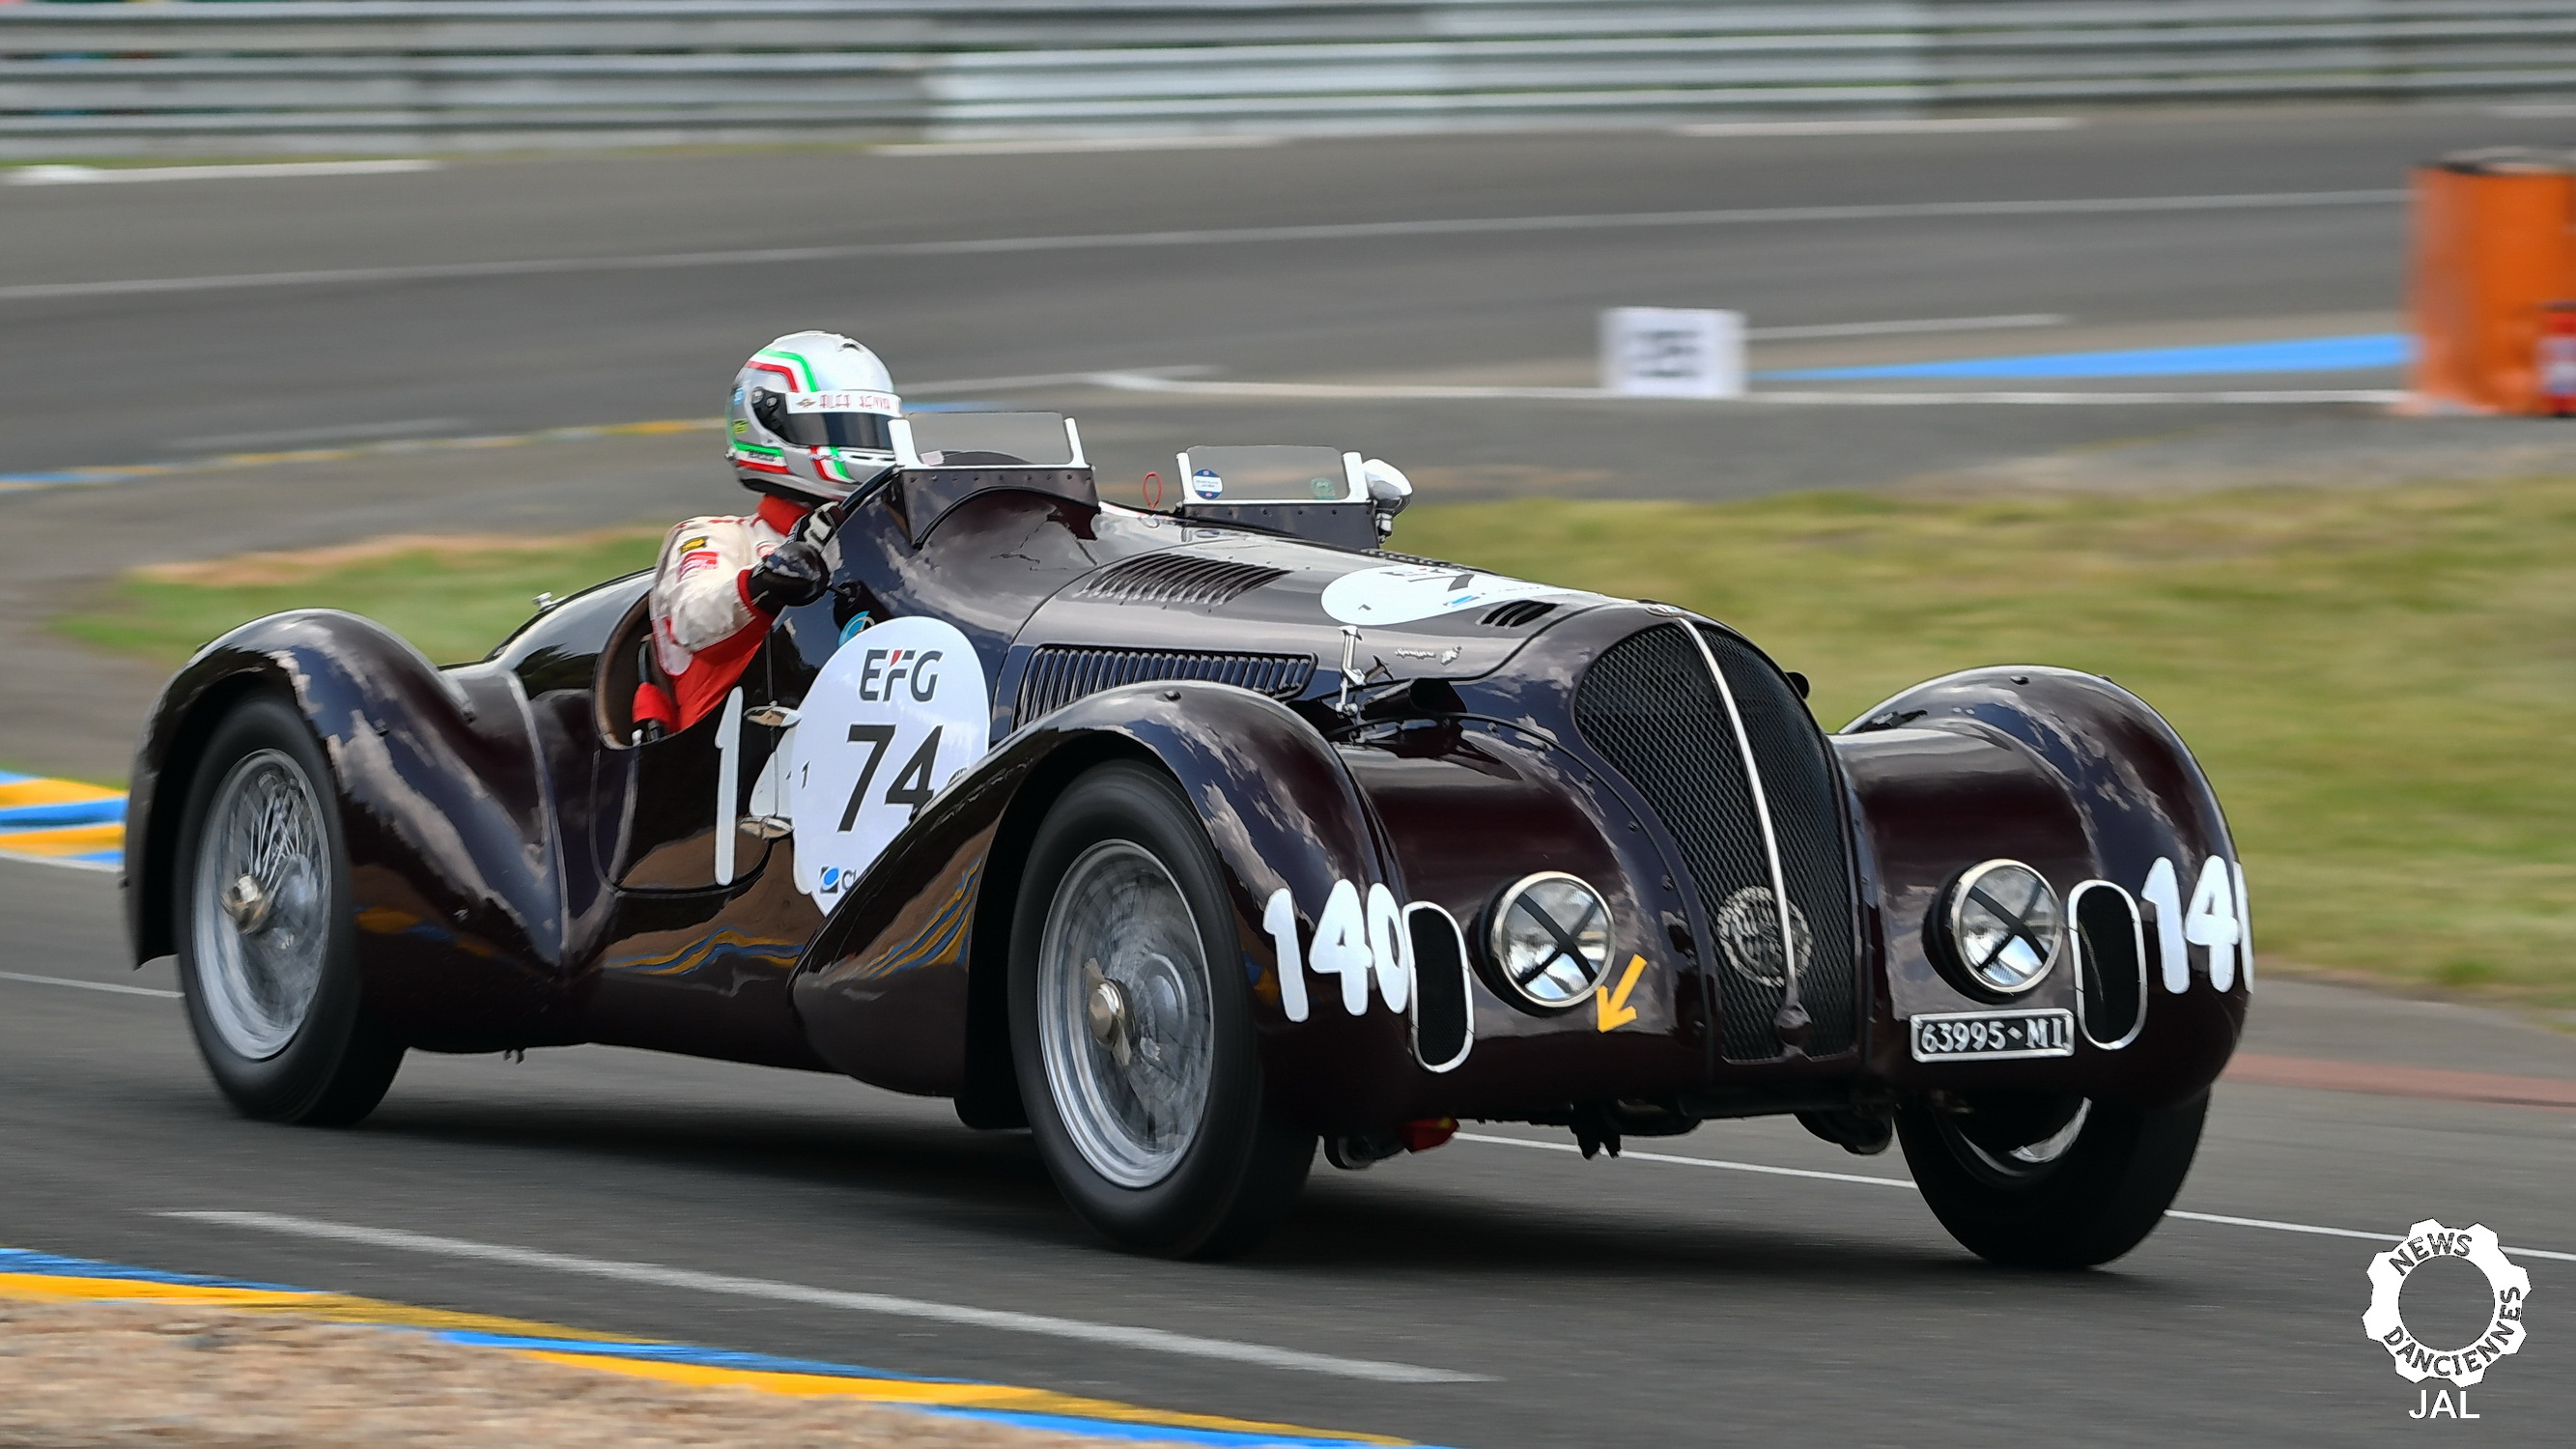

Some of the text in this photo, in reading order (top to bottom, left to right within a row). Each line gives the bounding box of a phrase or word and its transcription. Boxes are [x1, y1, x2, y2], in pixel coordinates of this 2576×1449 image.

[860, 649, 944, 702] EFG
[836, 724, 944, 833] 74
[1262, 879, 1409, 1023] 140
